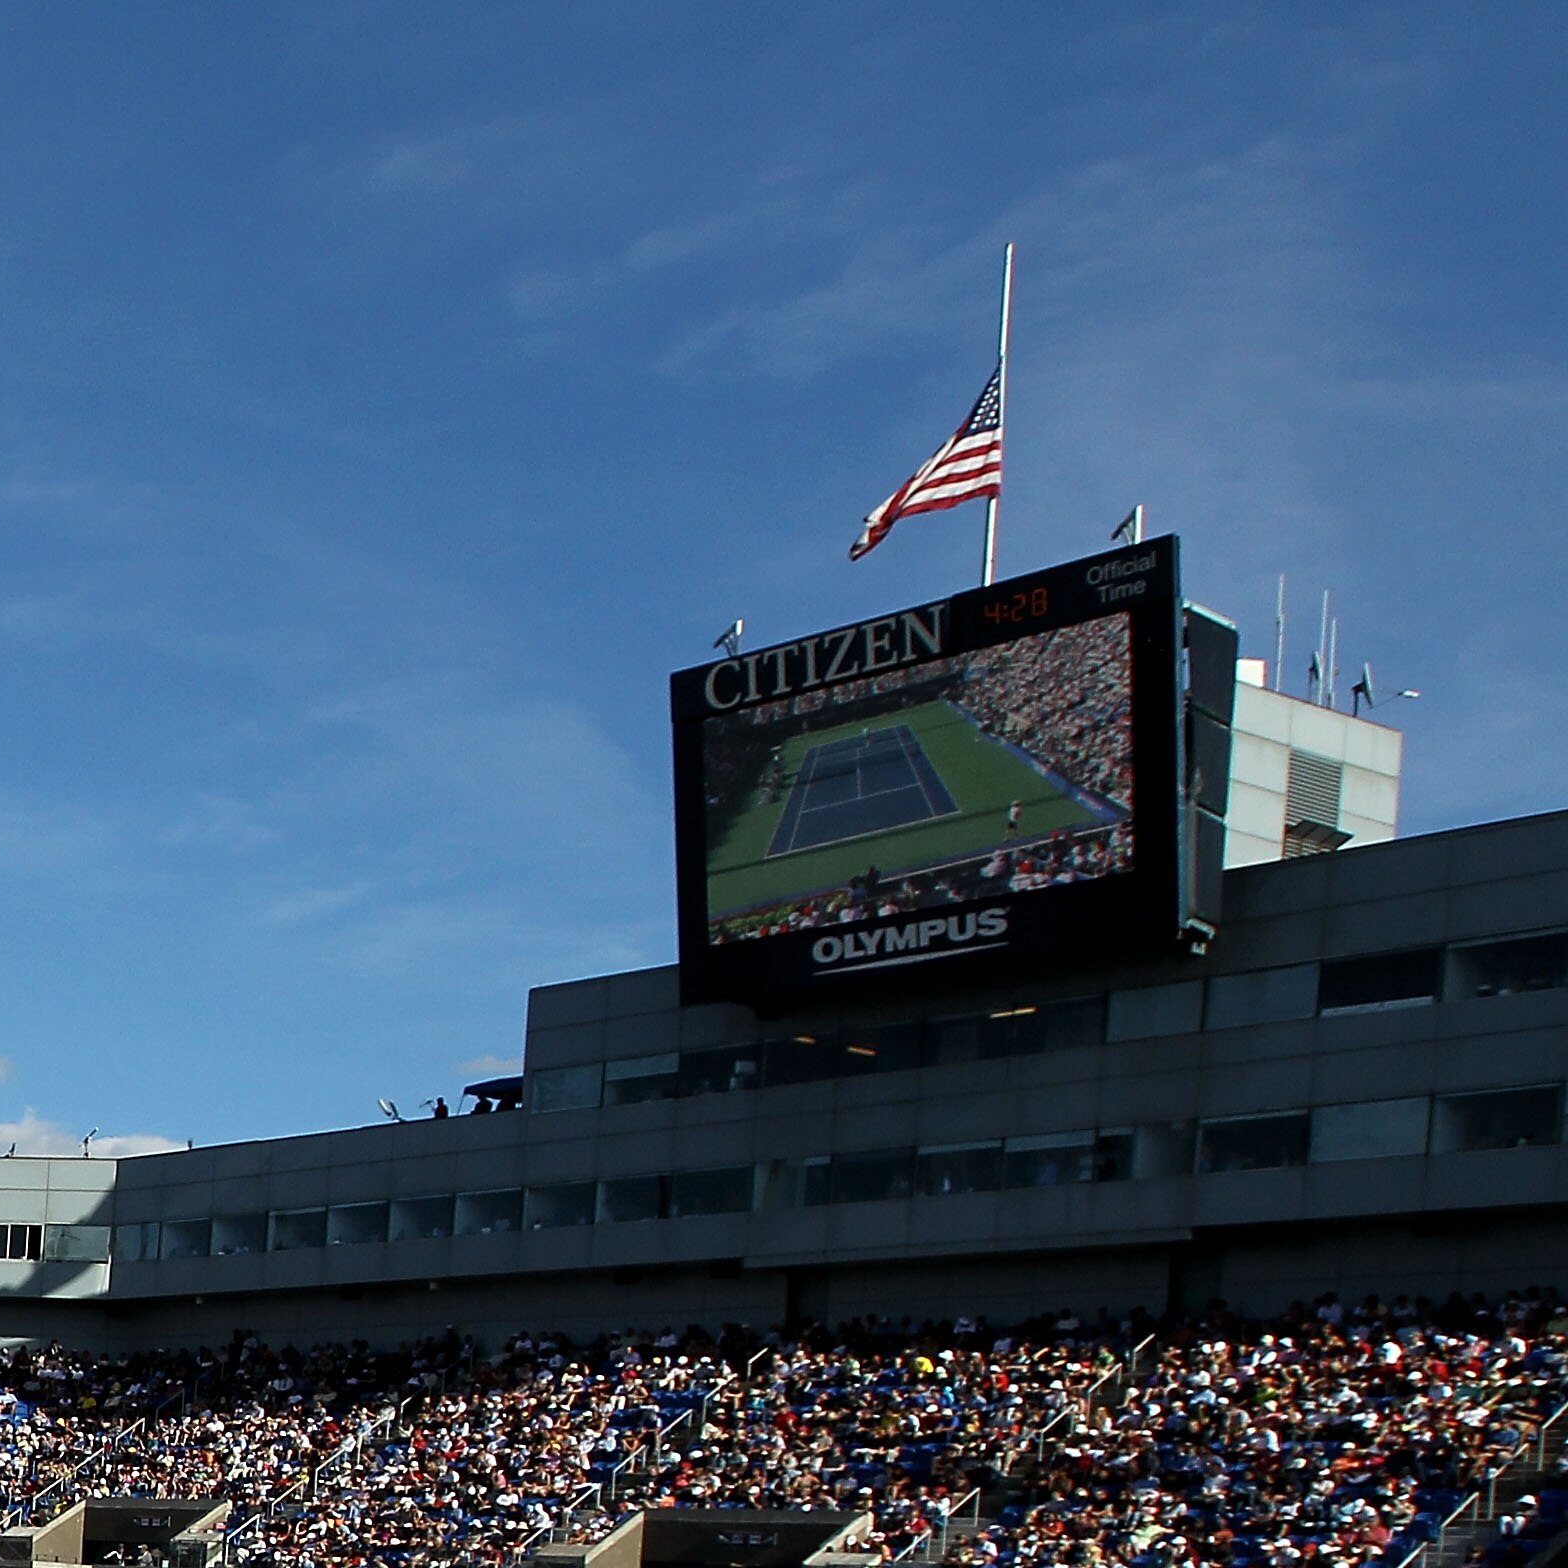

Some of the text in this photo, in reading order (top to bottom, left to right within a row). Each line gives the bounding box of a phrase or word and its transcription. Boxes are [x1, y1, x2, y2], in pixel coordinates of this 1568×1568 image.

[1087, 550, 1157, 585] Official
[983, 587, 1047, 625] 4:28
[1097, 579, 1147, 604] Time
[704, 603, 947, 711] CITIZEN
[812, 907, 1008, 964] OLYMPUS
